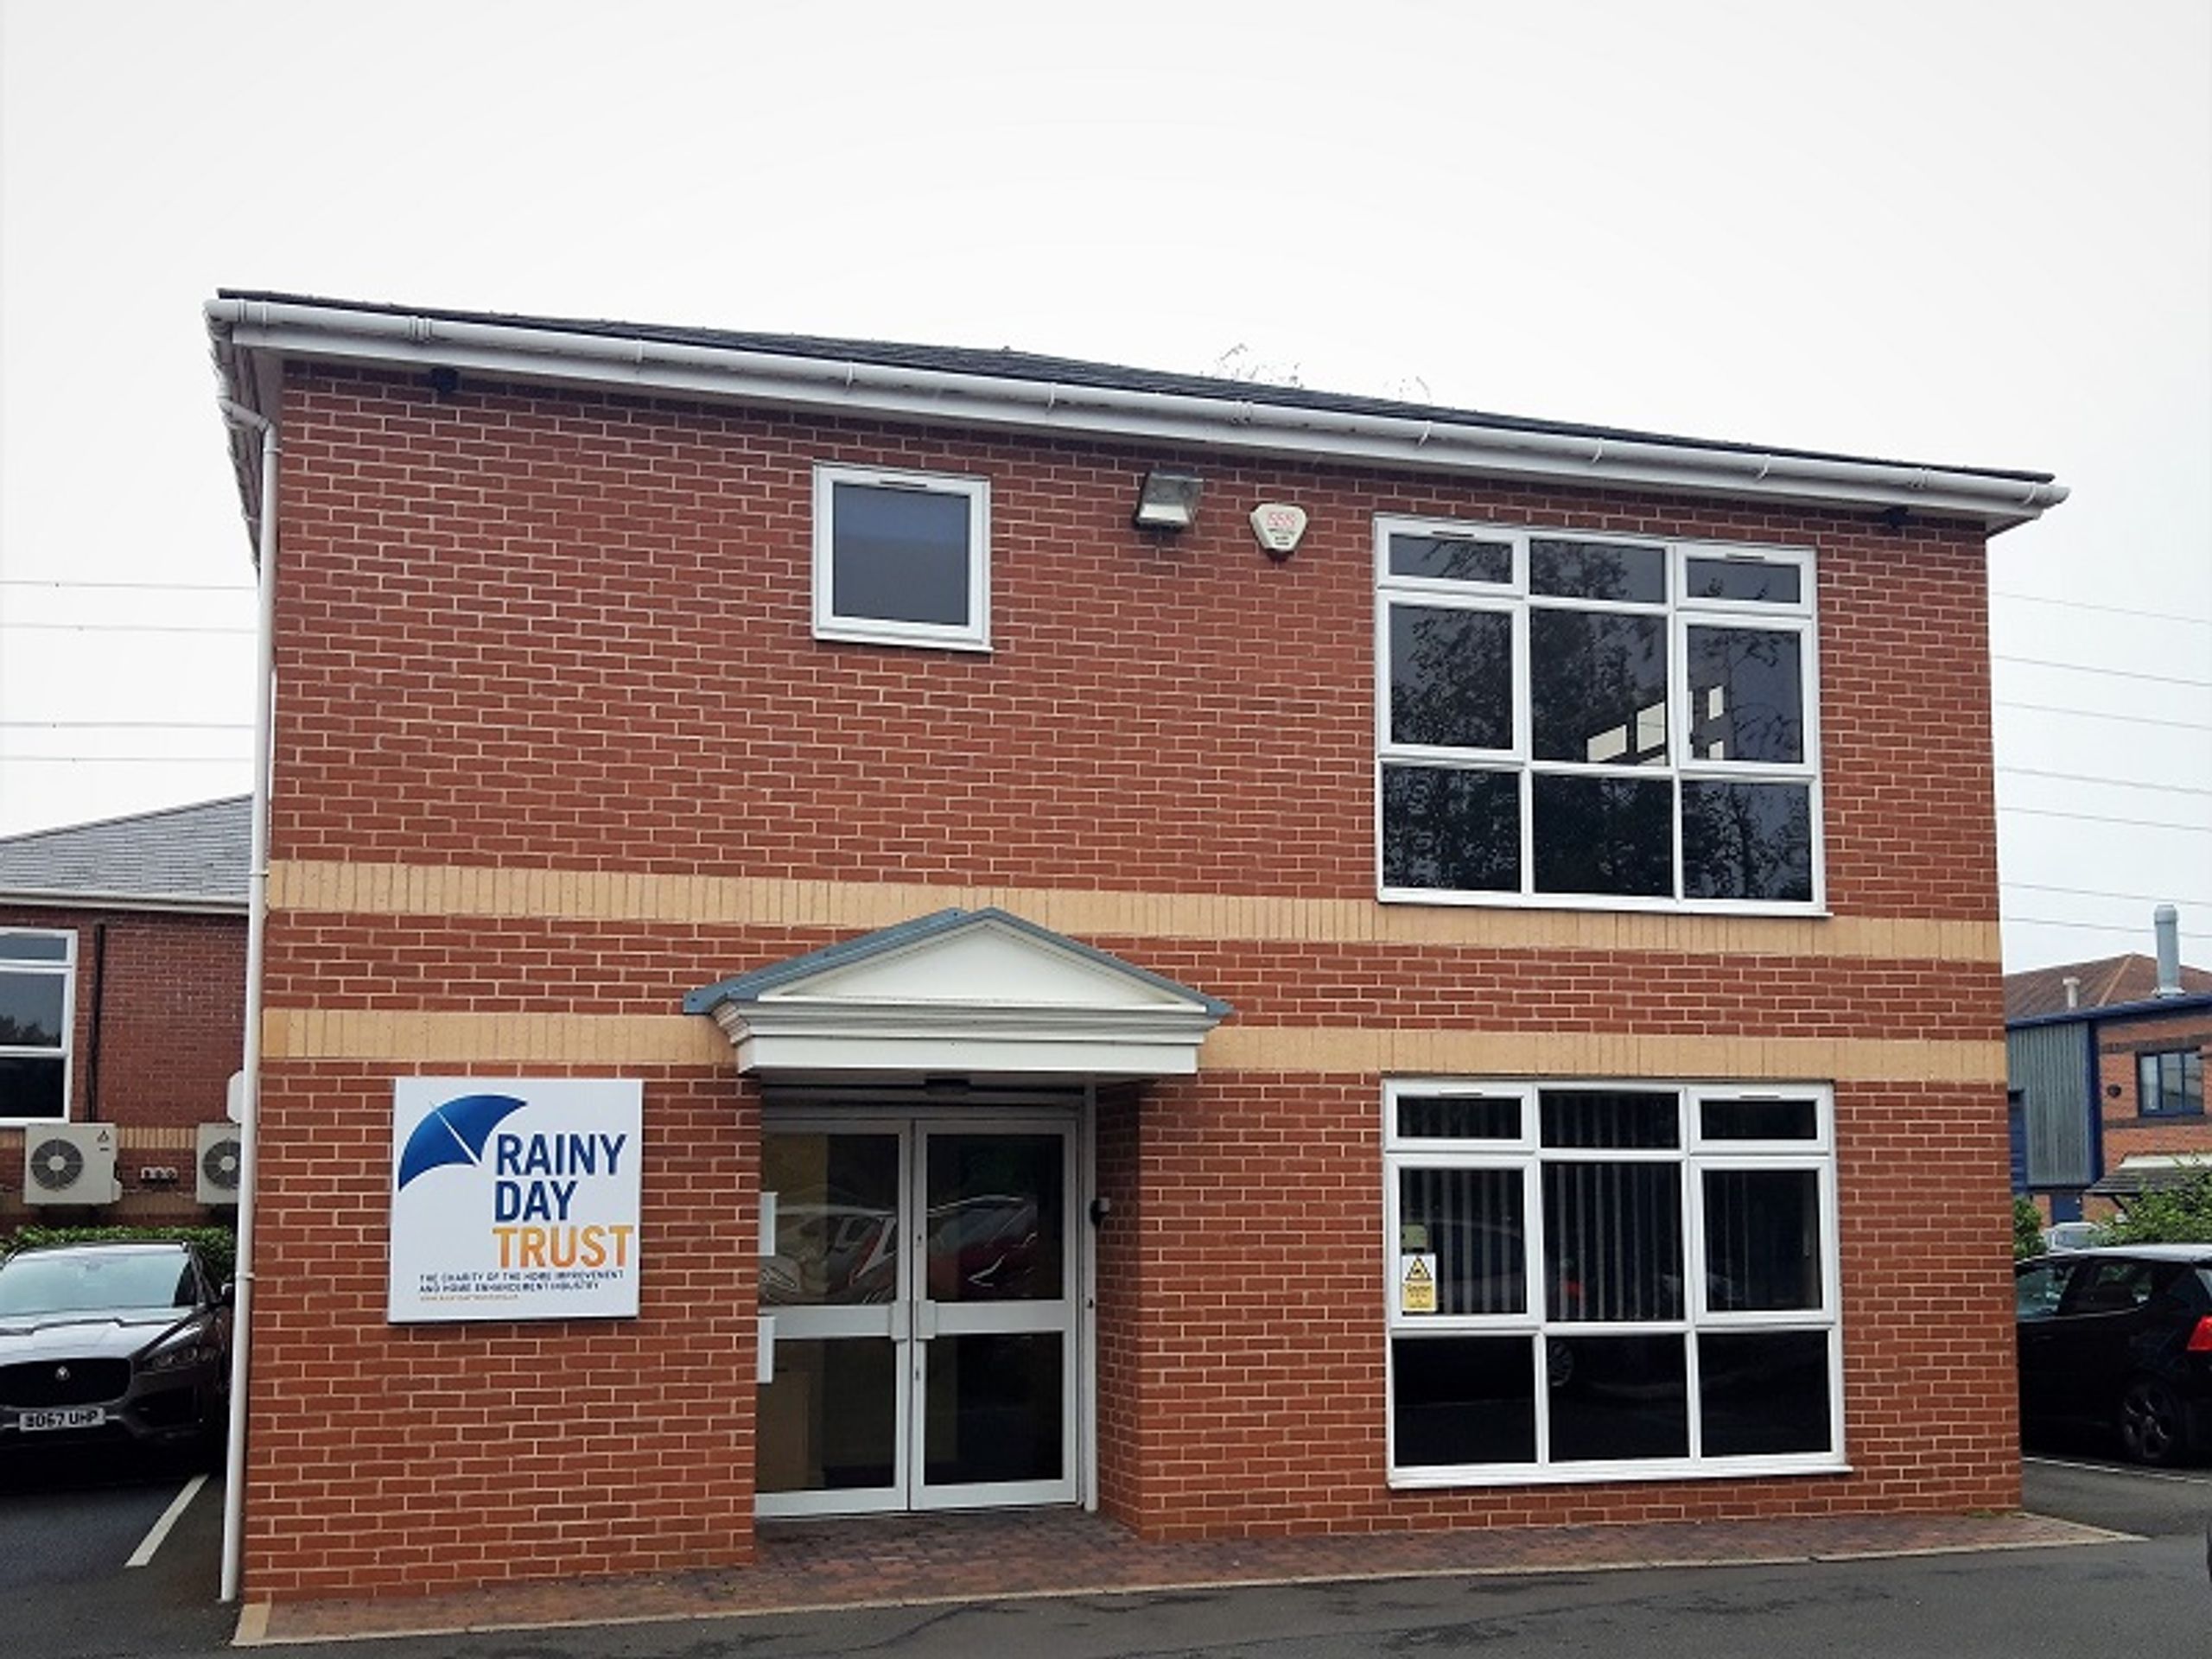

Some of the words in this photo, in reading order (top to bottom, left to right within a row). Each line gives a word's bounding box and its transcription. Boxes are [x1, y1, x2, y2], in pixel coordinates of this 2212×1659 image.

[496, 1133, 626, 1175] RAINY
[494, 1180, 578, 1222] DAY
[492, 1225, 634, 1268] TRUST
[420, 1273, 438, 1281] THE
[442, 1272, 484, 1281] CHARITY
[486, 1272, 499, 1281] OF
[503, 1272, 520, 1281] THE
[524, 1272, 551, 1281] HOME
[555, 1270, 624, 1280] IMPROVEMENT
[420, 1282, 440, 1293] AND
[442, 1283, 471, 1293] HOME
[475, 1282, 549, 1293] ENHANCEMENT
